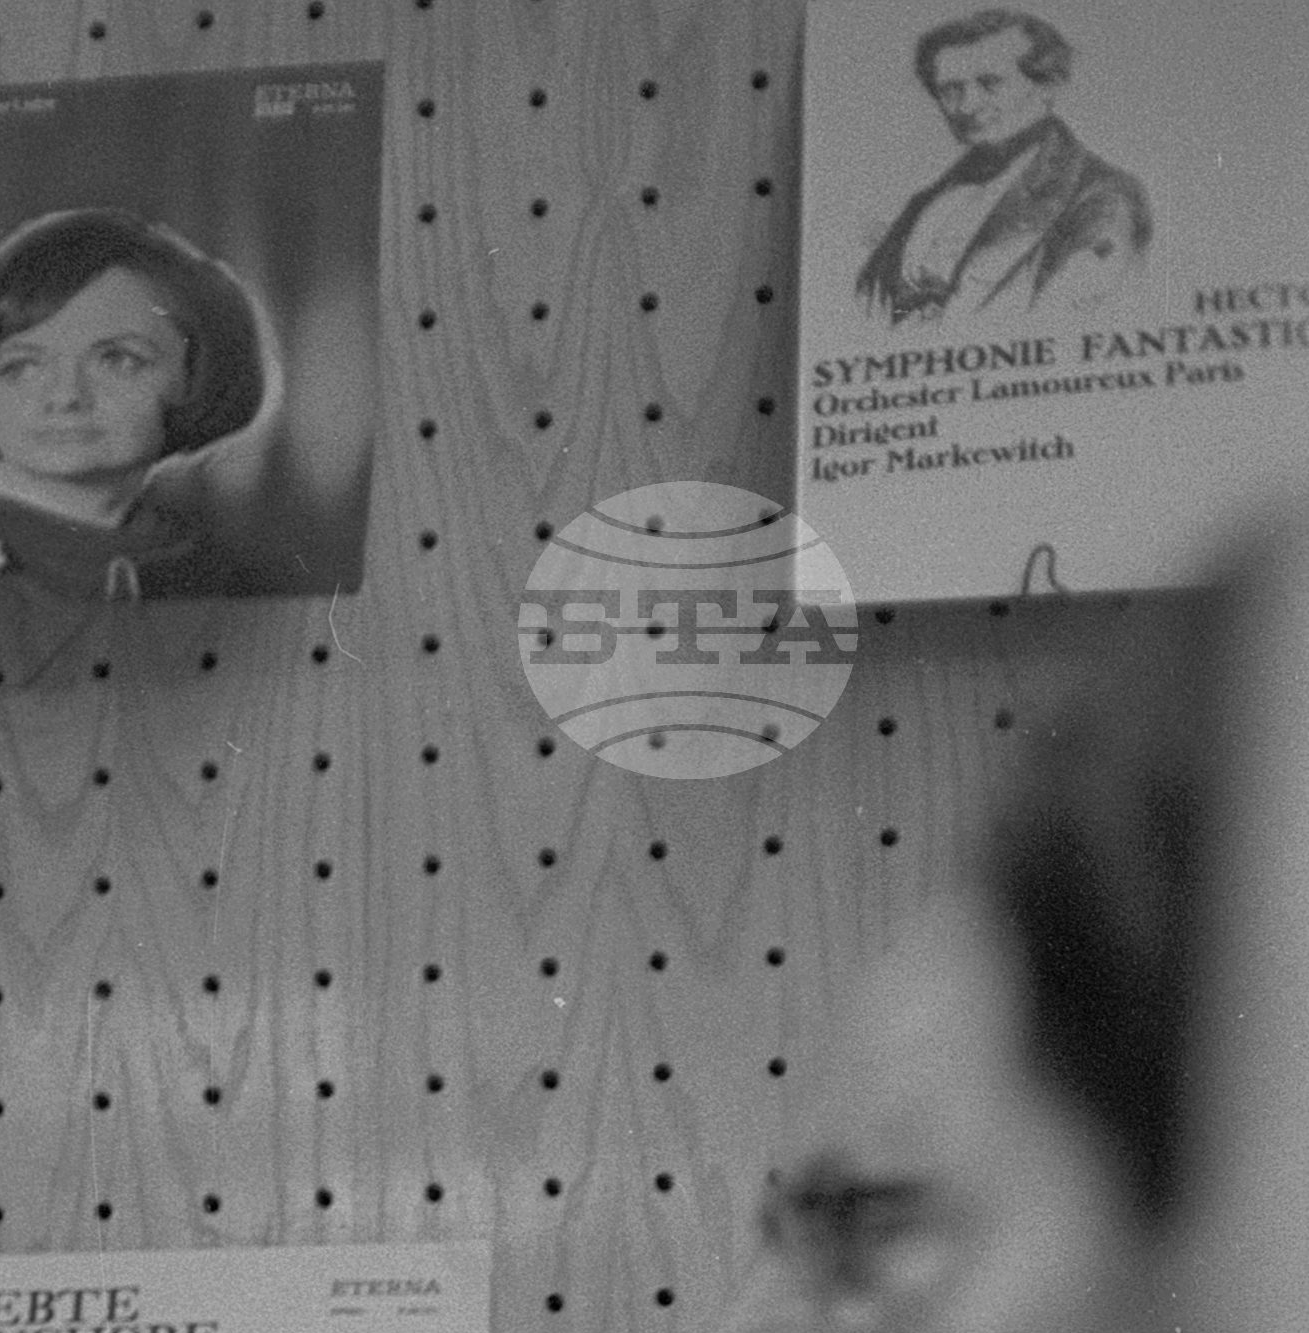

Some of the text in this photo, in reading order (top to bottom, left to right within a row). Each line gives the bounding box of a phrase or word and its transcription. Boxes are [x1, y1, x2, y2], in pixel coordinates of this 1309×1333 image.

[812, 338, 1056, 388] SYMPHONIE
[812, 360, 1246, 418] Orchester Lamoureux Paris
[812, 415, 940, 450] Dirigent
[812, 434, 1076, 482] Igor Markewitch
